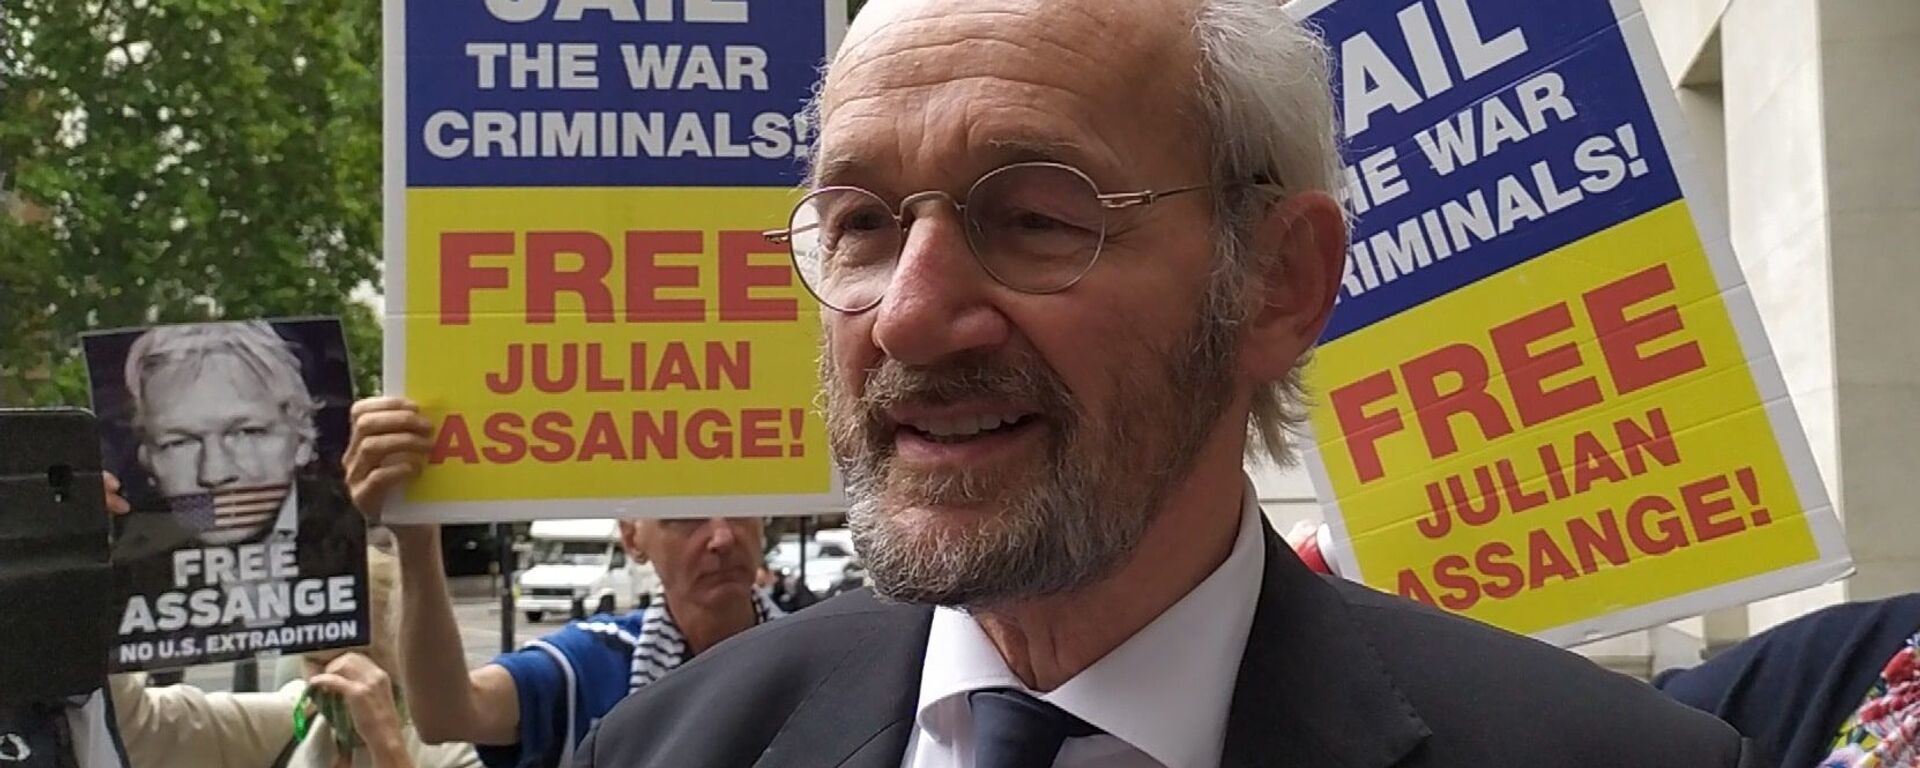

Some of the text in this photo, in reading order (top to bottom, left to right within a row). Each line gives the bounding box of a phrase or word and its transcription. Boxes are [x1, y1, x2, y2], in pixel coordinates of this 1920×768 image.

[466, 43, 768, 90] THE WAR
[1341, 0, 1529, 139] AIL
[423, 110, 808, 159] CRIMINALS!
[1413, 72, 1578, 175] WAR
[439, 231, 799, 325] FREE
[486, 341, 751, 394] JULIAN
[1329, 263, 1707, 485] FREE
[428, 408, 804, 465] ASSANGE!
[1415, 408, 1682, 540] JULIAN
[173, 541, 300, 587] FREE
[1397, 466, 1773, 610] ASSANGE!
[118, 576, 357, 635] ASSANGE
[119, 620, 358, 664] NO U.S. EXTRADITION
